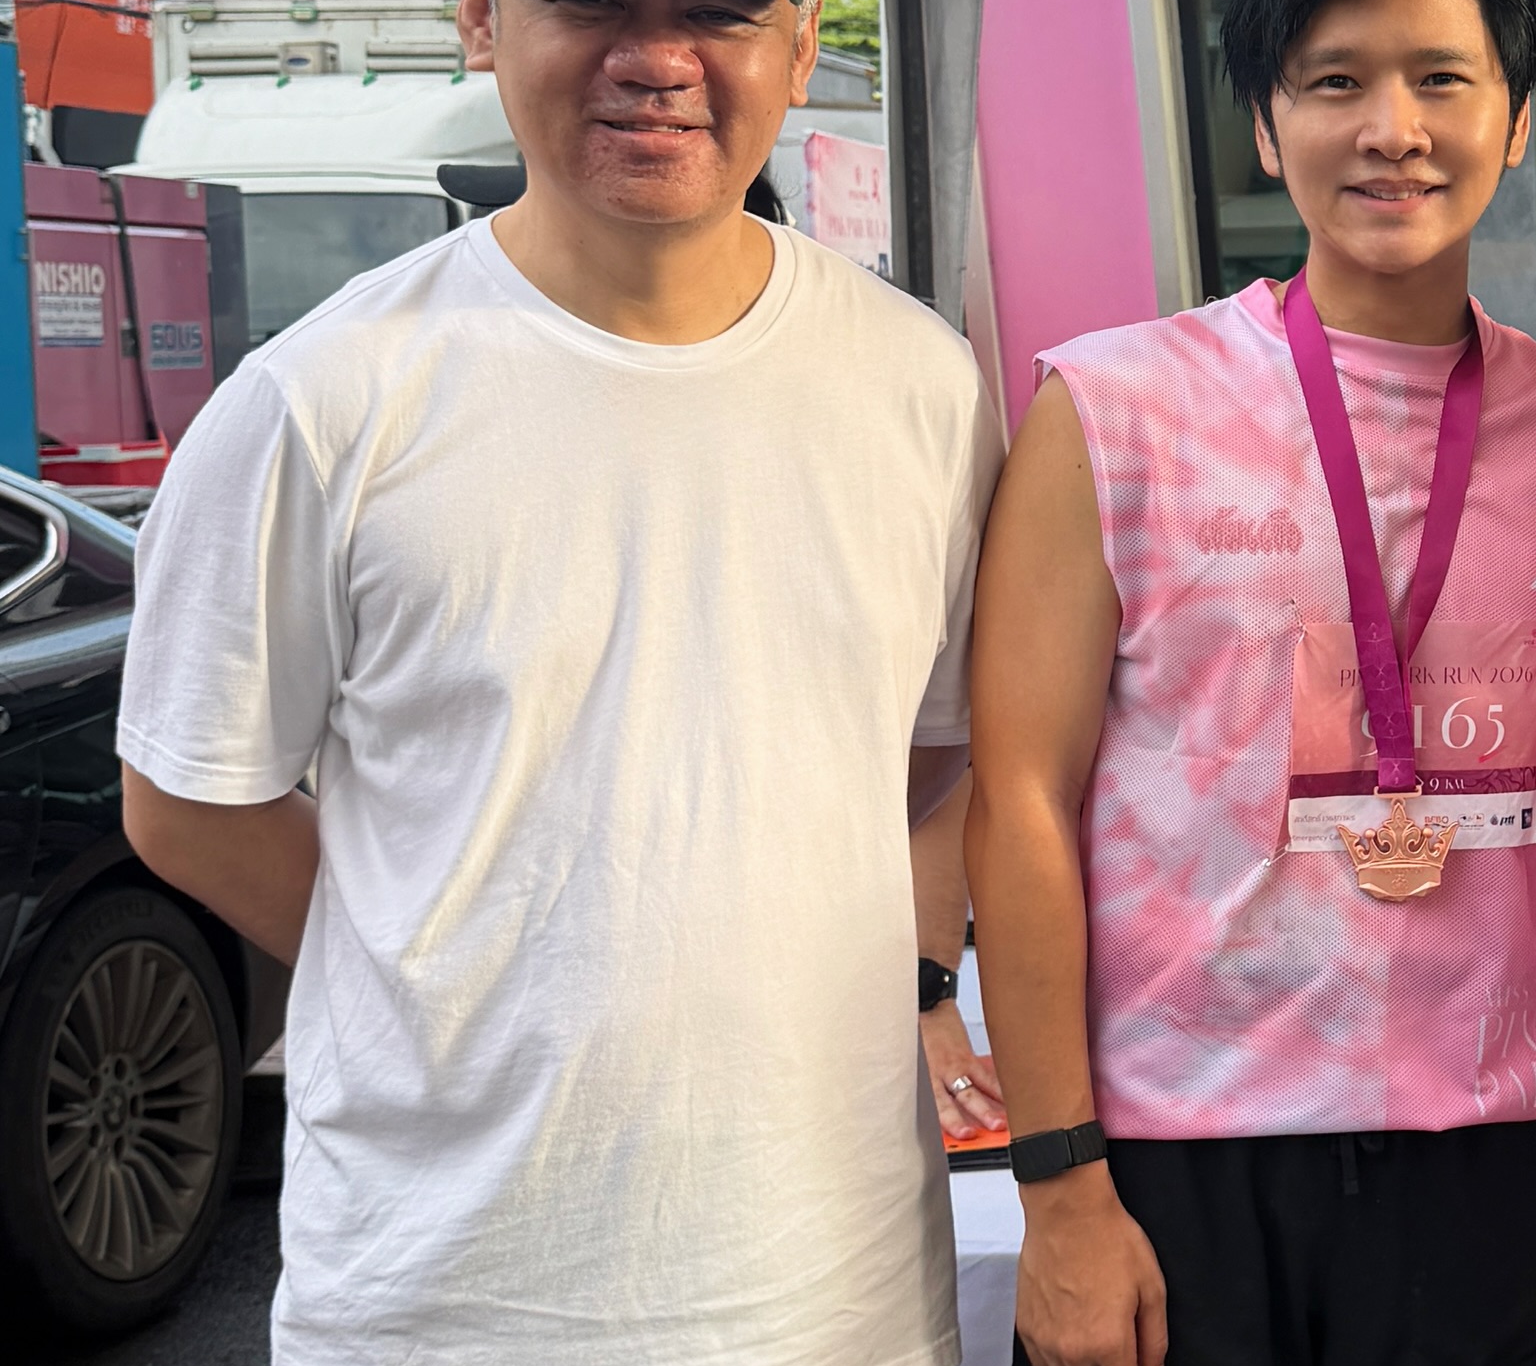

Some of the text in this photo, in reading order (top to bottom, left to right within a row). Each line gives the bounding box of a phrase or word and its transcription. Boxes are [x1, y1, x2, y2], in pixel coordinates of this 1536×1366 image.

[34, 261, 106, 296] NISHIO
[1444, 666, 1483, 684] RUN
[1488, 666, 1534, 684] 2026
[1429, 777, 1440, 791] 9
